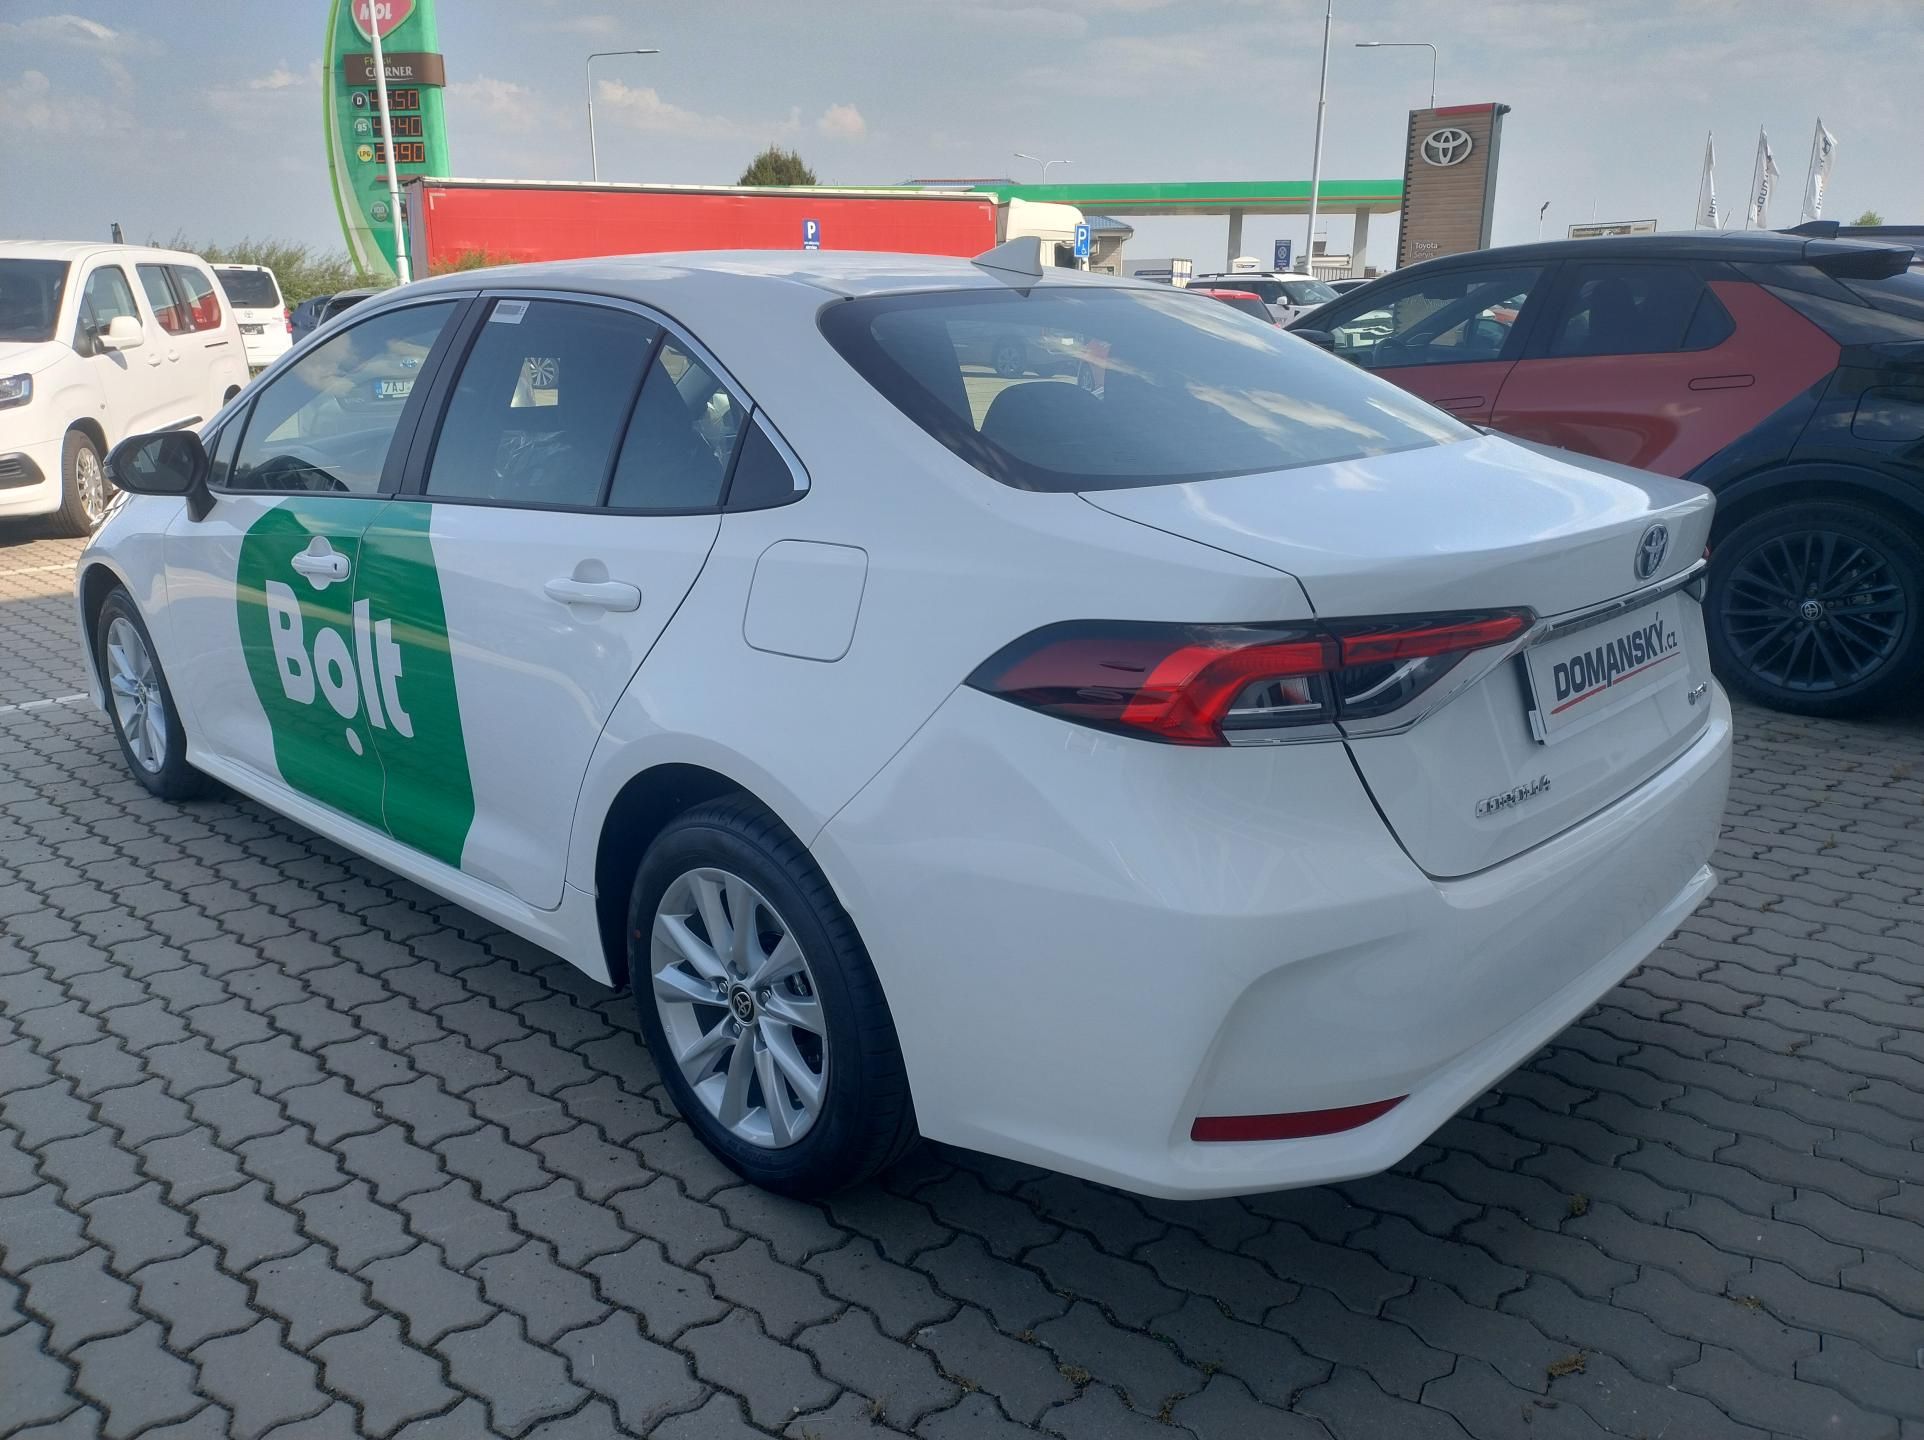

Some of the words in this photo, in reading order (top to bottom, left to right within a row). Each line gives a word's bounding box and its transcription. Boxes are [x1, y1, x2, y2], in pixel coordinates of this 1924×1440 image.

[360, 3, 392, 20] MOL
[807, 221, 816, 239] P
[1078, 228, 1087, 247] P
[1415, 242, 1438, 250] Toyota
[265, 579, 414, 738] Bolt
